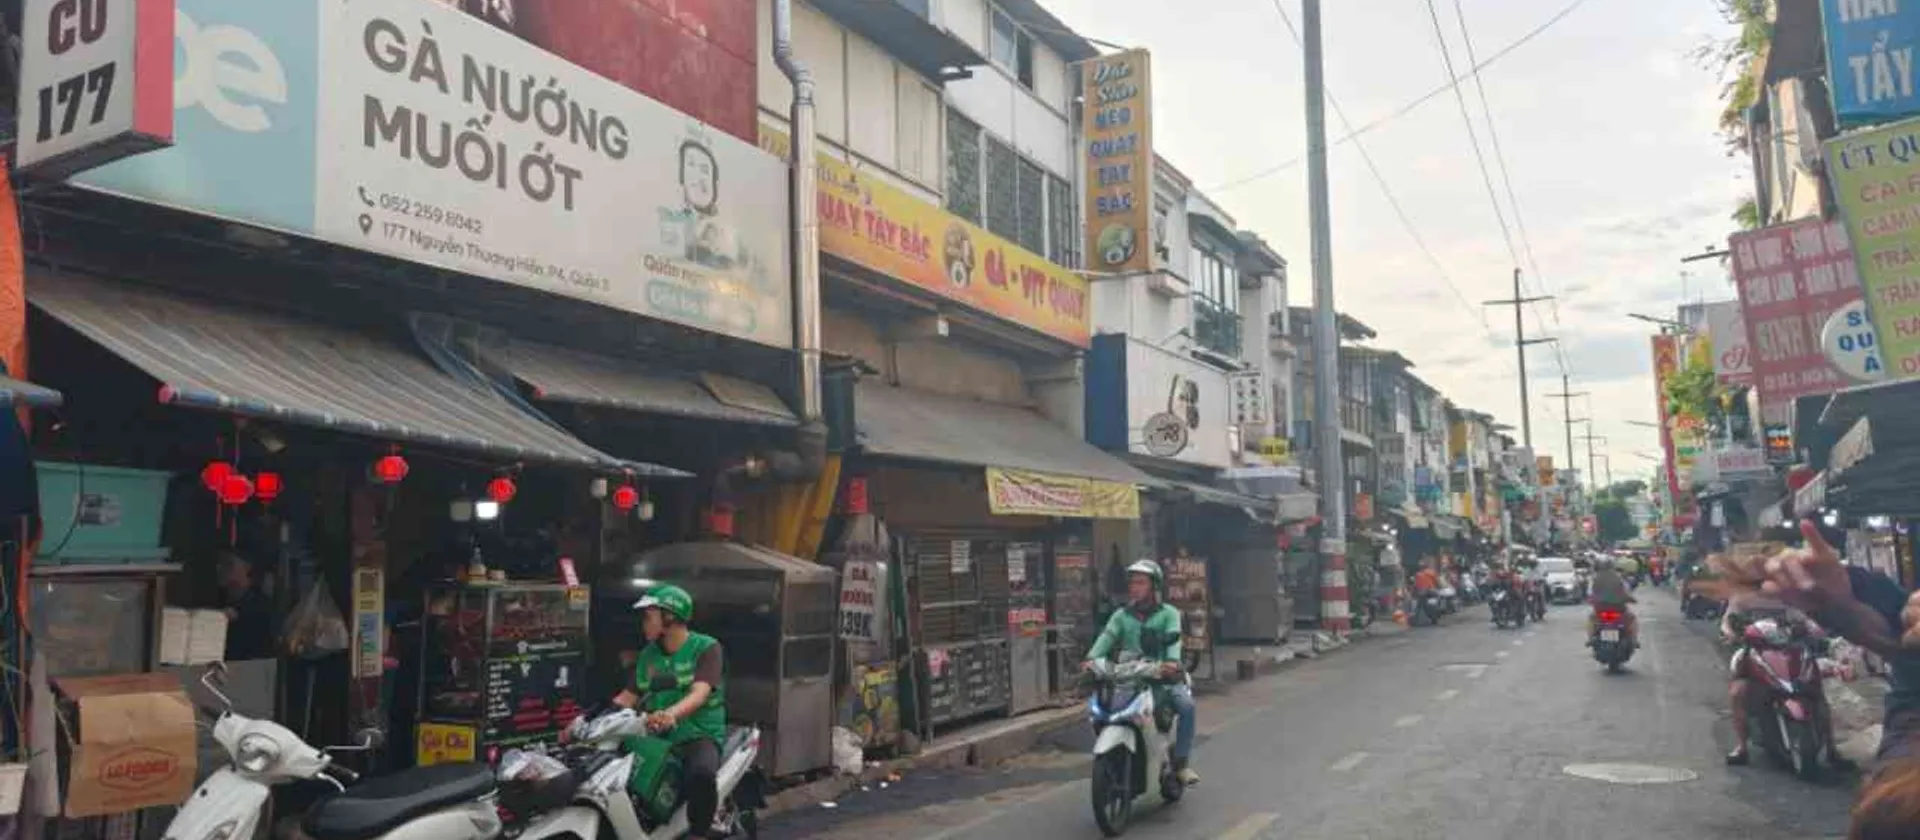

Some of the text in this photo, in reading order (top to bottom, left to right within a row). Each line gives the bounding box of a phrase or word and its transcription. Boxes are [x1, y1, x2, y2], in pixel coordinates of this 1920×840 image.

[36, 61, 116, 142] 177
[363, 18, 629, 160] GÀ NƯỚNG
[363, 94, 582, 212] MUỐI ỚT
[383, 222, 406, 241] 177
